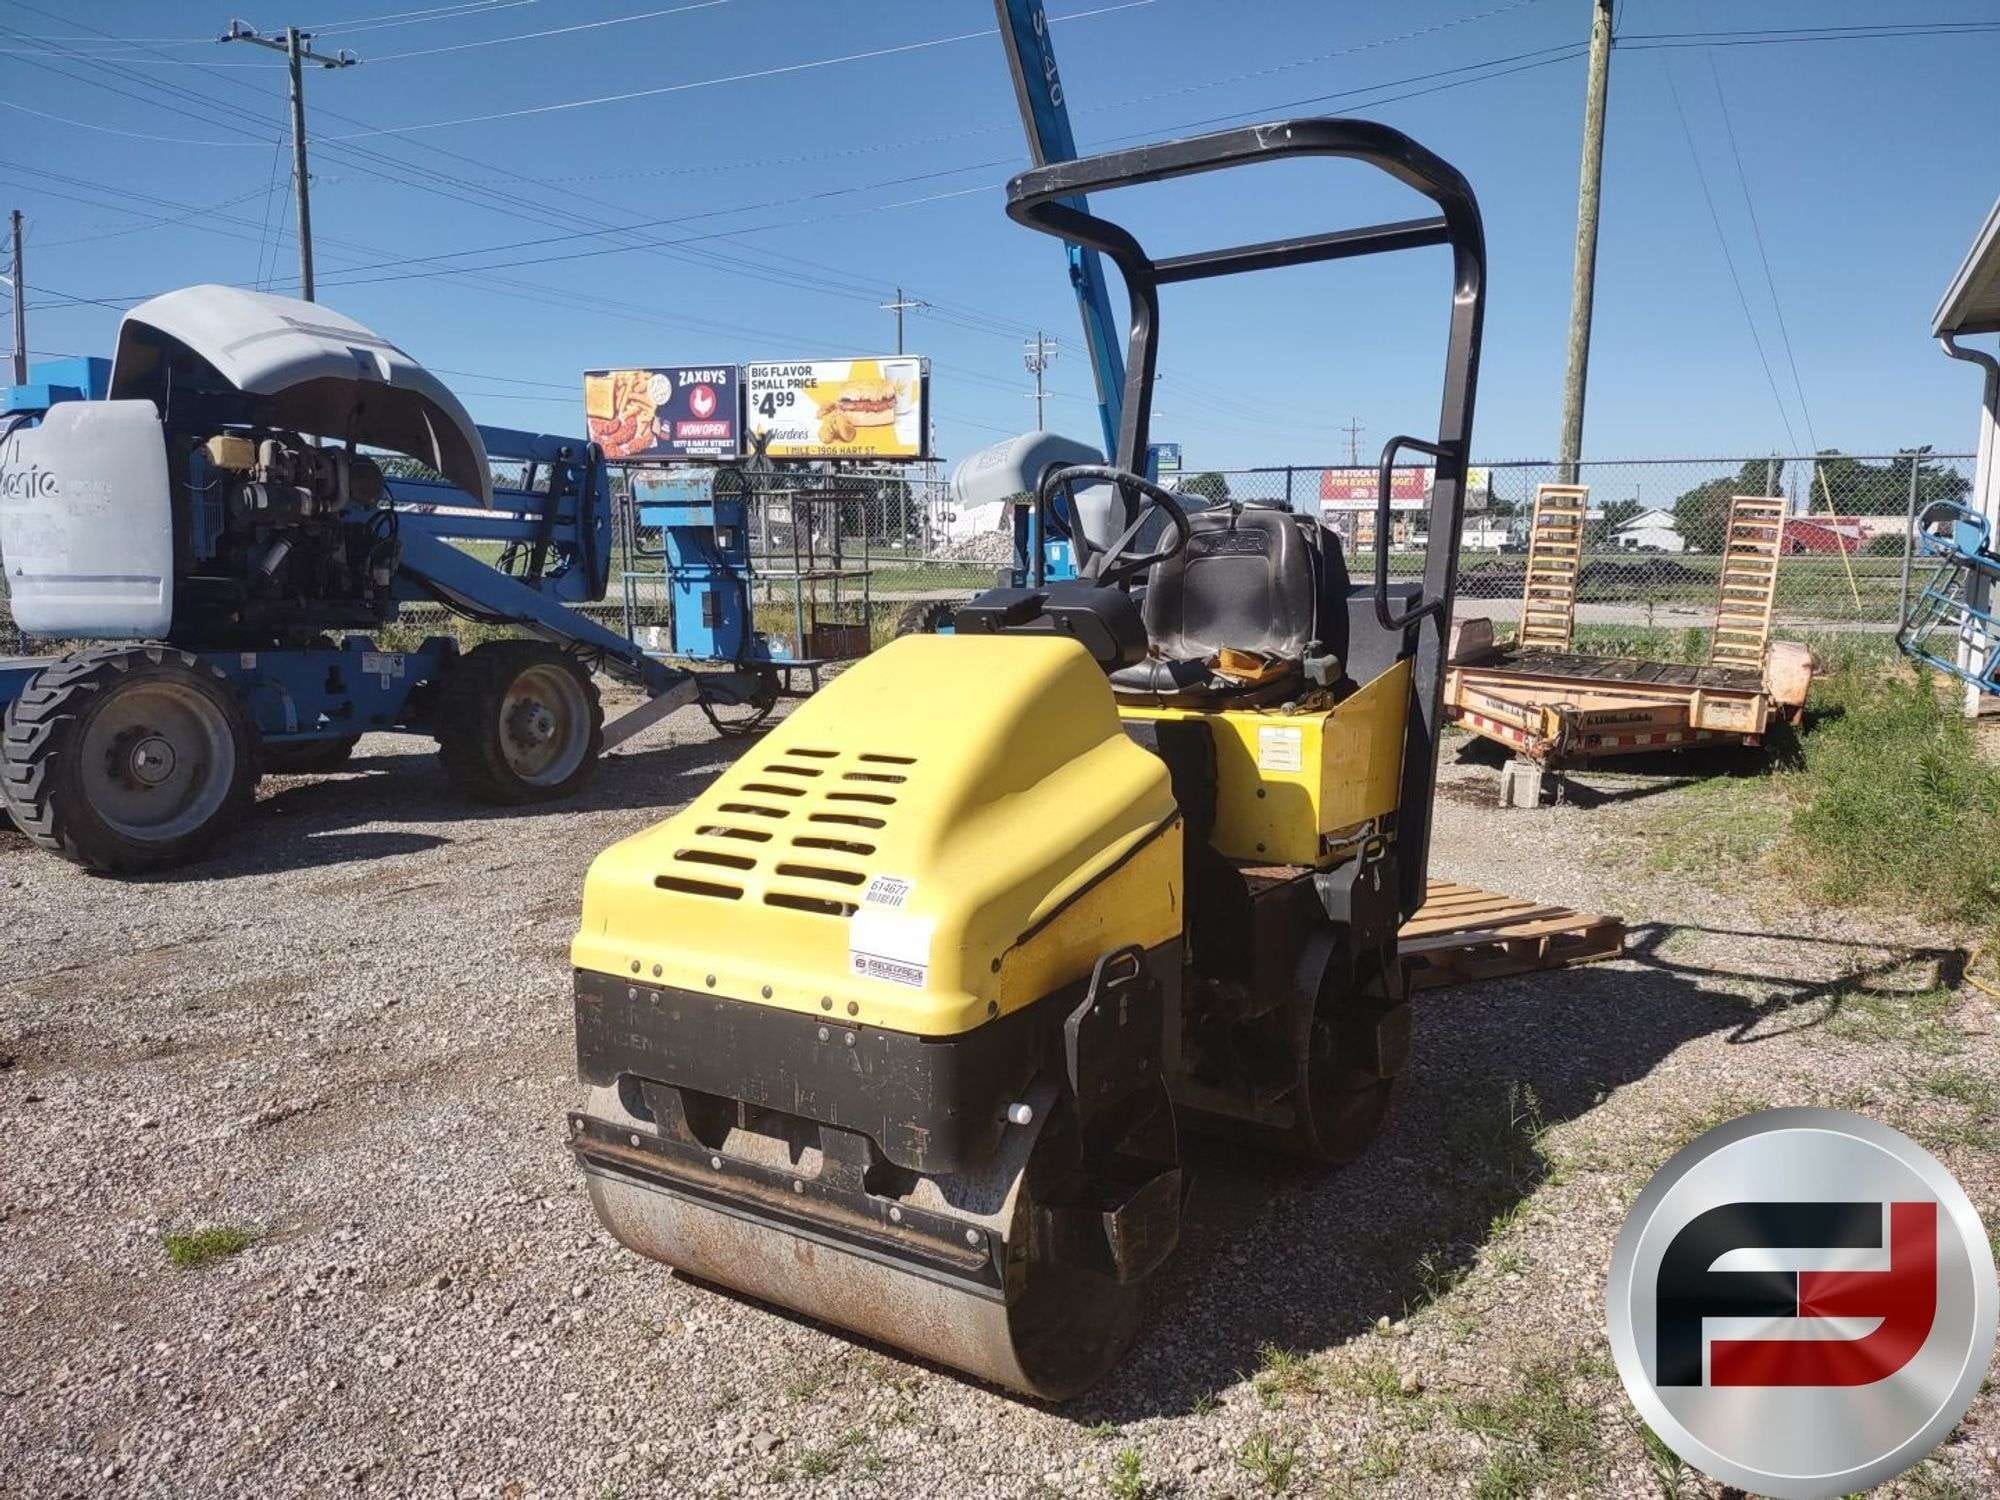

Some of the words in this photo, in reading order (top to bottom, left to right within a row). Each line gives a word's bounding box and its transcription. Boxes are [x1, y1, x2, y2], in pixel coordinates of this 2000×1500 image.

[1033, 9, 1062, 107] S-40
[751, 367, 769, 378] BIG
[770, 364, 812, 376] FLAVOR
[679, 370, 727, 387] ZAXBYS
[751, 379, 785, 390] SMALL
[787, 378, 818, 389] PRICE
[680, 424, 701, 436] NOW
[702, 424, 727, 436] OPEN
[791, 446, 809, 455] MILE
[818, 446, 838, 455] 1906
[840, 446, 863, 455] HART
